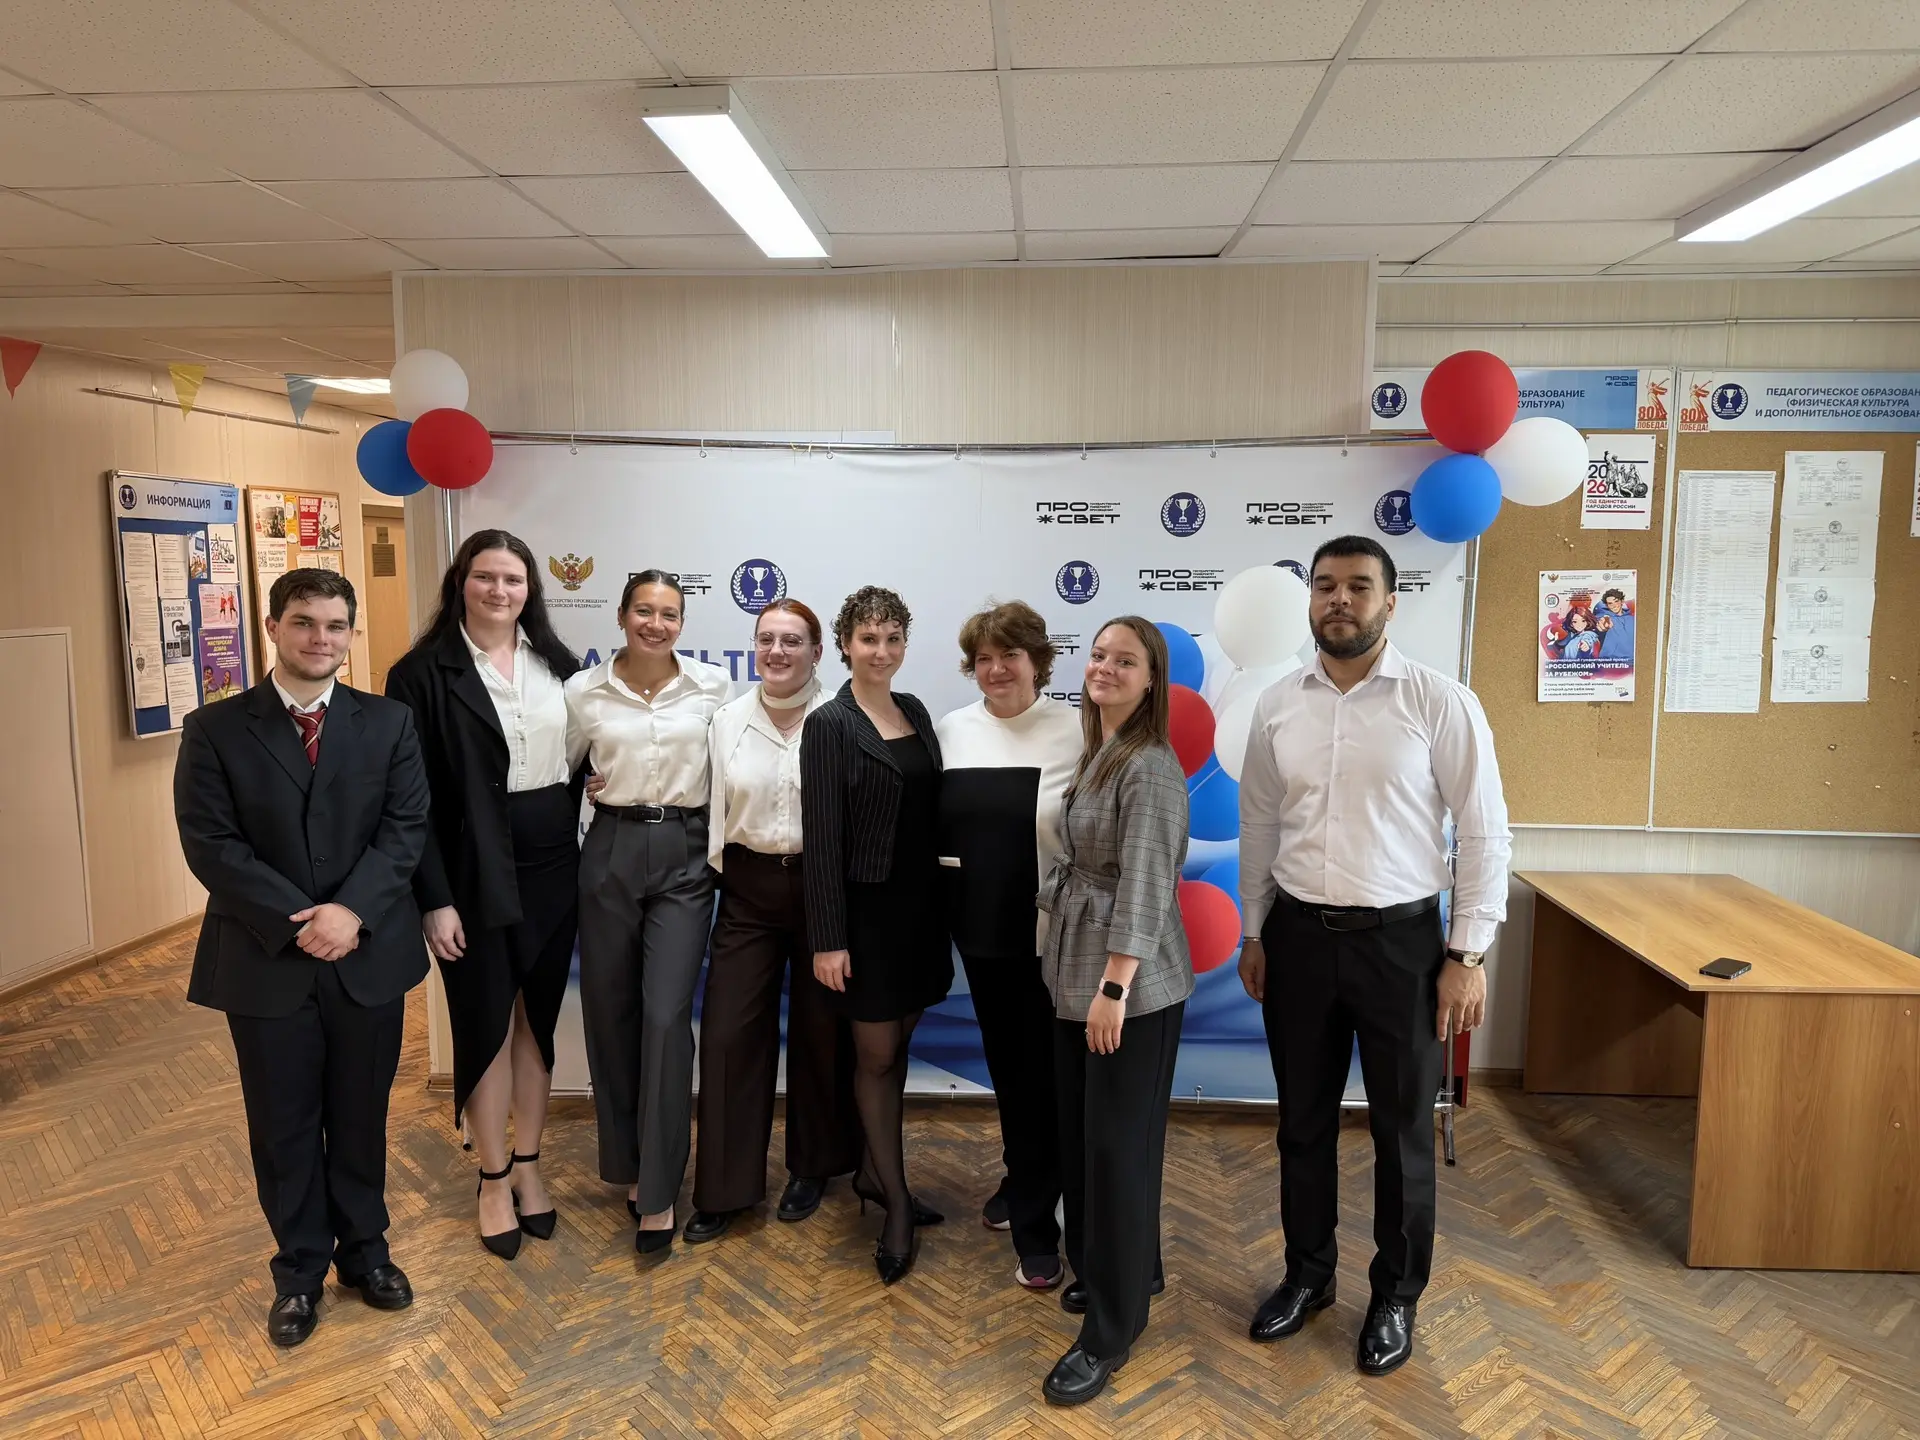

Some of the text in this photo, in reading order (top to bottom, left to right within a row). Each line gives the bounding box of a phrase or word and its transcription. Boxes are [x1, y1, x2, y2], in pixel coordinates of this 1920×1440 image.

[1766, 388, 1859, 397] ПЕДАГОГИЧЕСКОЕ
[1786, 398, 1909, 407] (ФИЗИЧЕСКАЯ КУЛЬТУРА
[1638, 406, 1655, 420] 80
[1680, 408, 1696, 421] 80
[1755, 409, 1763, 417] И
[1764, 409, 1862, 418] ДОПОЛНИТЕЛЬНОЕ
[1637, 421, 1667, 430] ПОБЕДА!
[1680, 424, 1709, 432] ПОБЕДА!
[1588, 464, 1608, 479] 20
[1587, 479, 1607, 494] 26
[146, 494, 211, 510] ИНФОРМАЦИЯ
[1036, 502, 1089, 512] ПРО
[1246, 502, 1300, 513] ПРО
[1057, 514, 1121, 524] СВЕТ
[1267, 515, 1333, 525] СВЕТ
[1139, 569, 1192, 579] ПРО
[682, 585, 712, 595] ЕТ
[1160, 581, 1224, 591] СВЕТ
[1395, 582, 1431, 592] ЕТ
